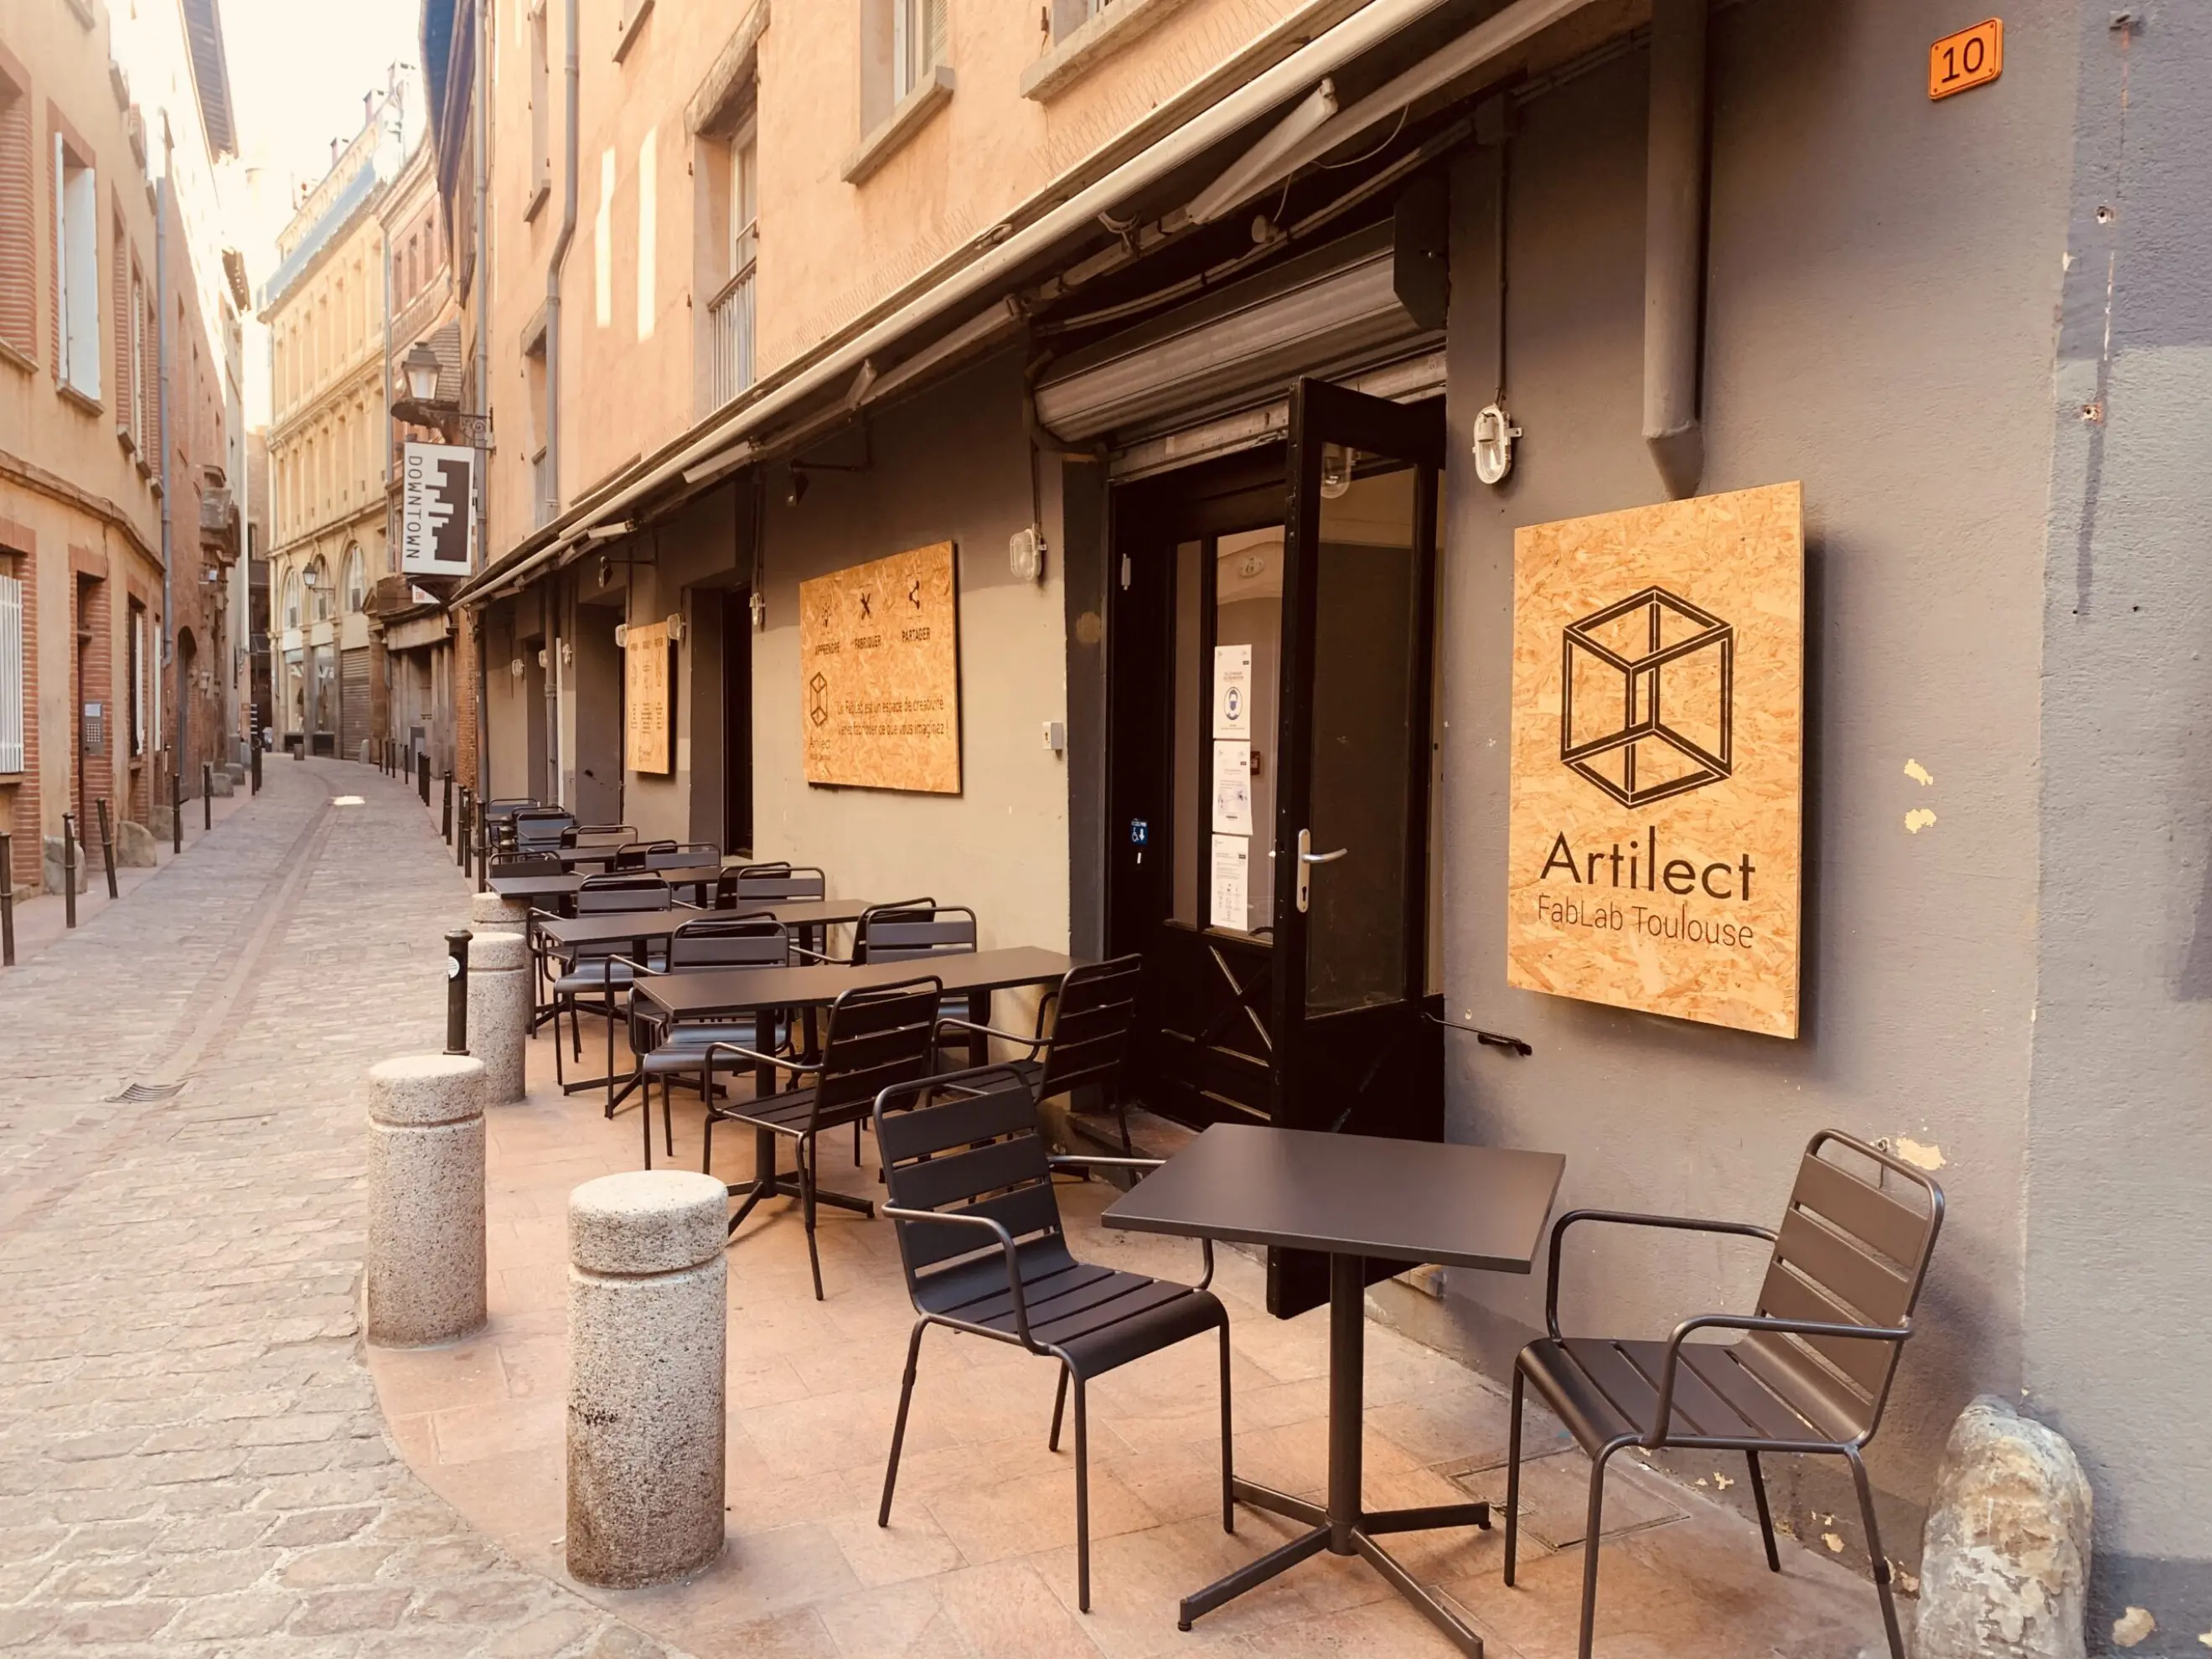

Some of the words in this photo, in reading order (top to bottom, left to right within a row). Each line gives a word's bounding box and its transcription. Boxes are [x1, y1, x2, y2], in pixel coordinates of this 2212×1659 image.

[1941, 37, 1985, 83] 10
[406, 456, 422, 558] DOWNTOWN
[855, 634, 881, 650] FABRIQUER
[902, 627, 930, 643] PARTAGER
[1540, 825, 1755, 901] Artilect
[1538, 893, 1623, 931] FabLab
[1631, 904, 1754, 948] Toulouse
